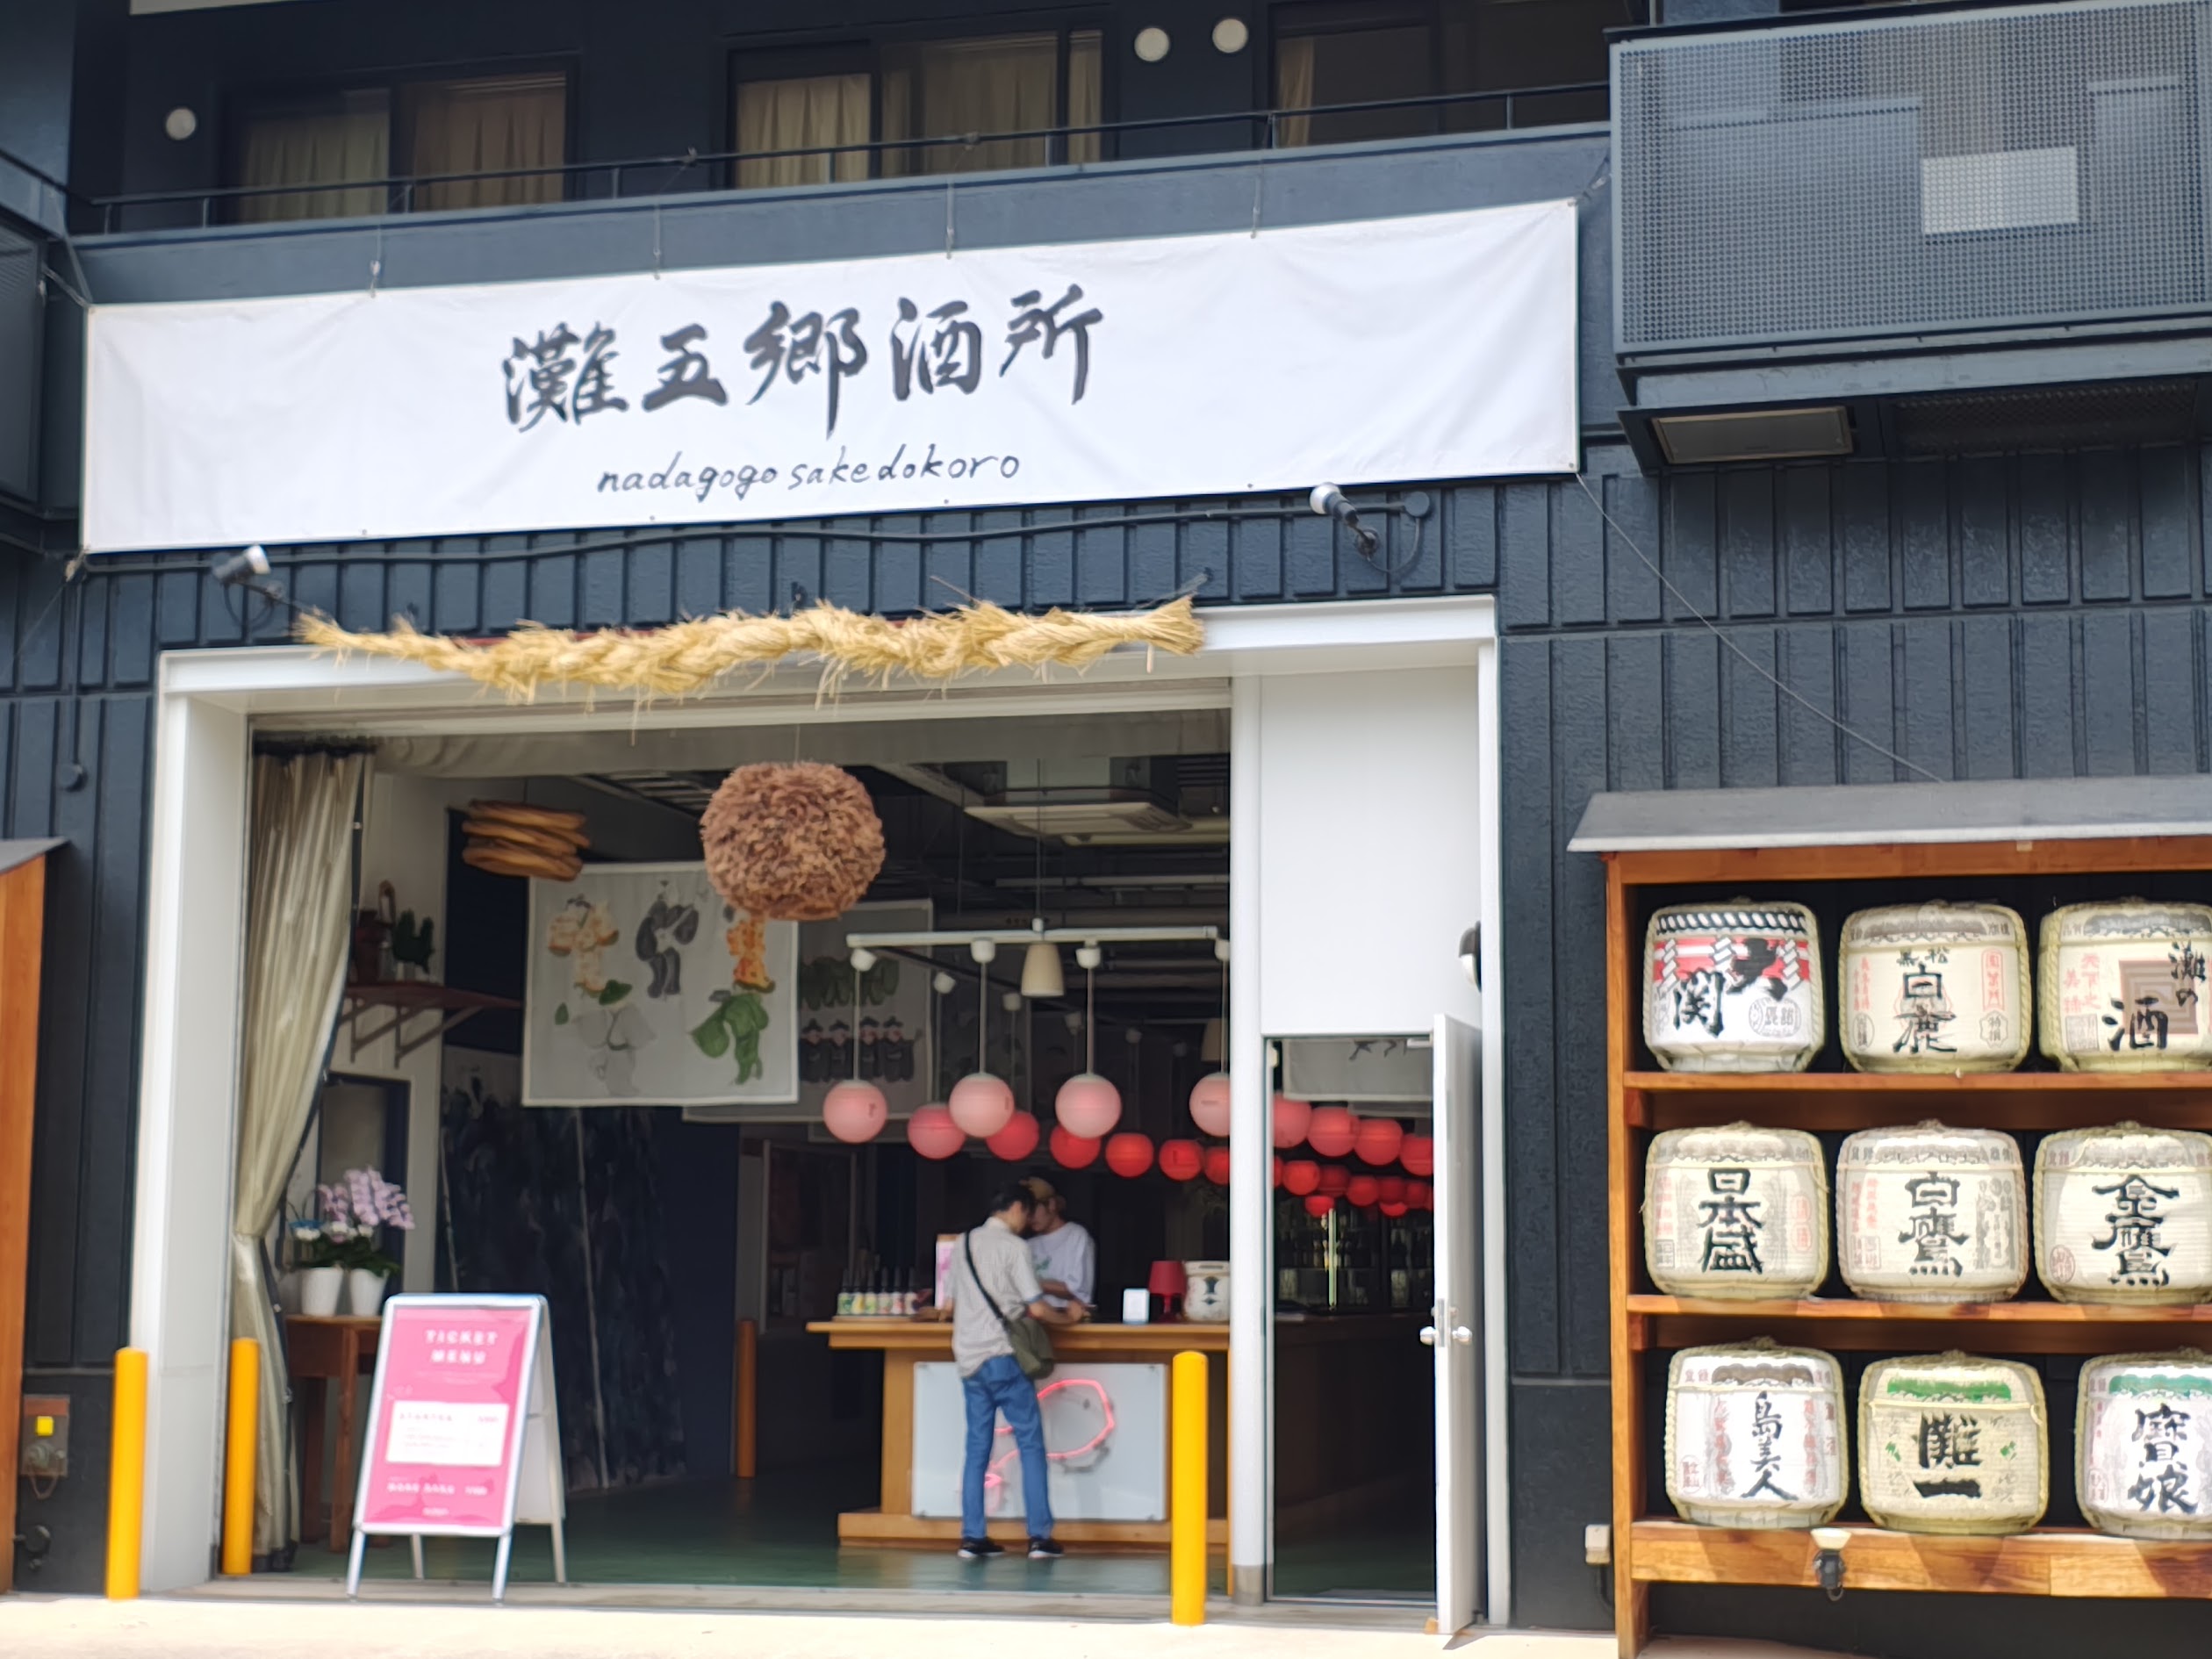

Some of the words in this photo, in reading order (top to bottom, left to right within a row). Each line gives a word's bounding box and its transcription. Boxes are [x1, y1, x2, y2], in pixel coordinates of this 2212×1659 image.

[502, 284, 1103, 440] 灘五郷酒所
[597, 450, 778, 502] nadagogo
[1697, 1167, 1766, 1275] 日本盛
[1898, 1171, 1970, 1277] 白鷹
[425, 1329, 498, 1345] TICKET
[431, 1349, 486, 1365] MENU
[1741, 1390, 1799, 1502] 島美人
